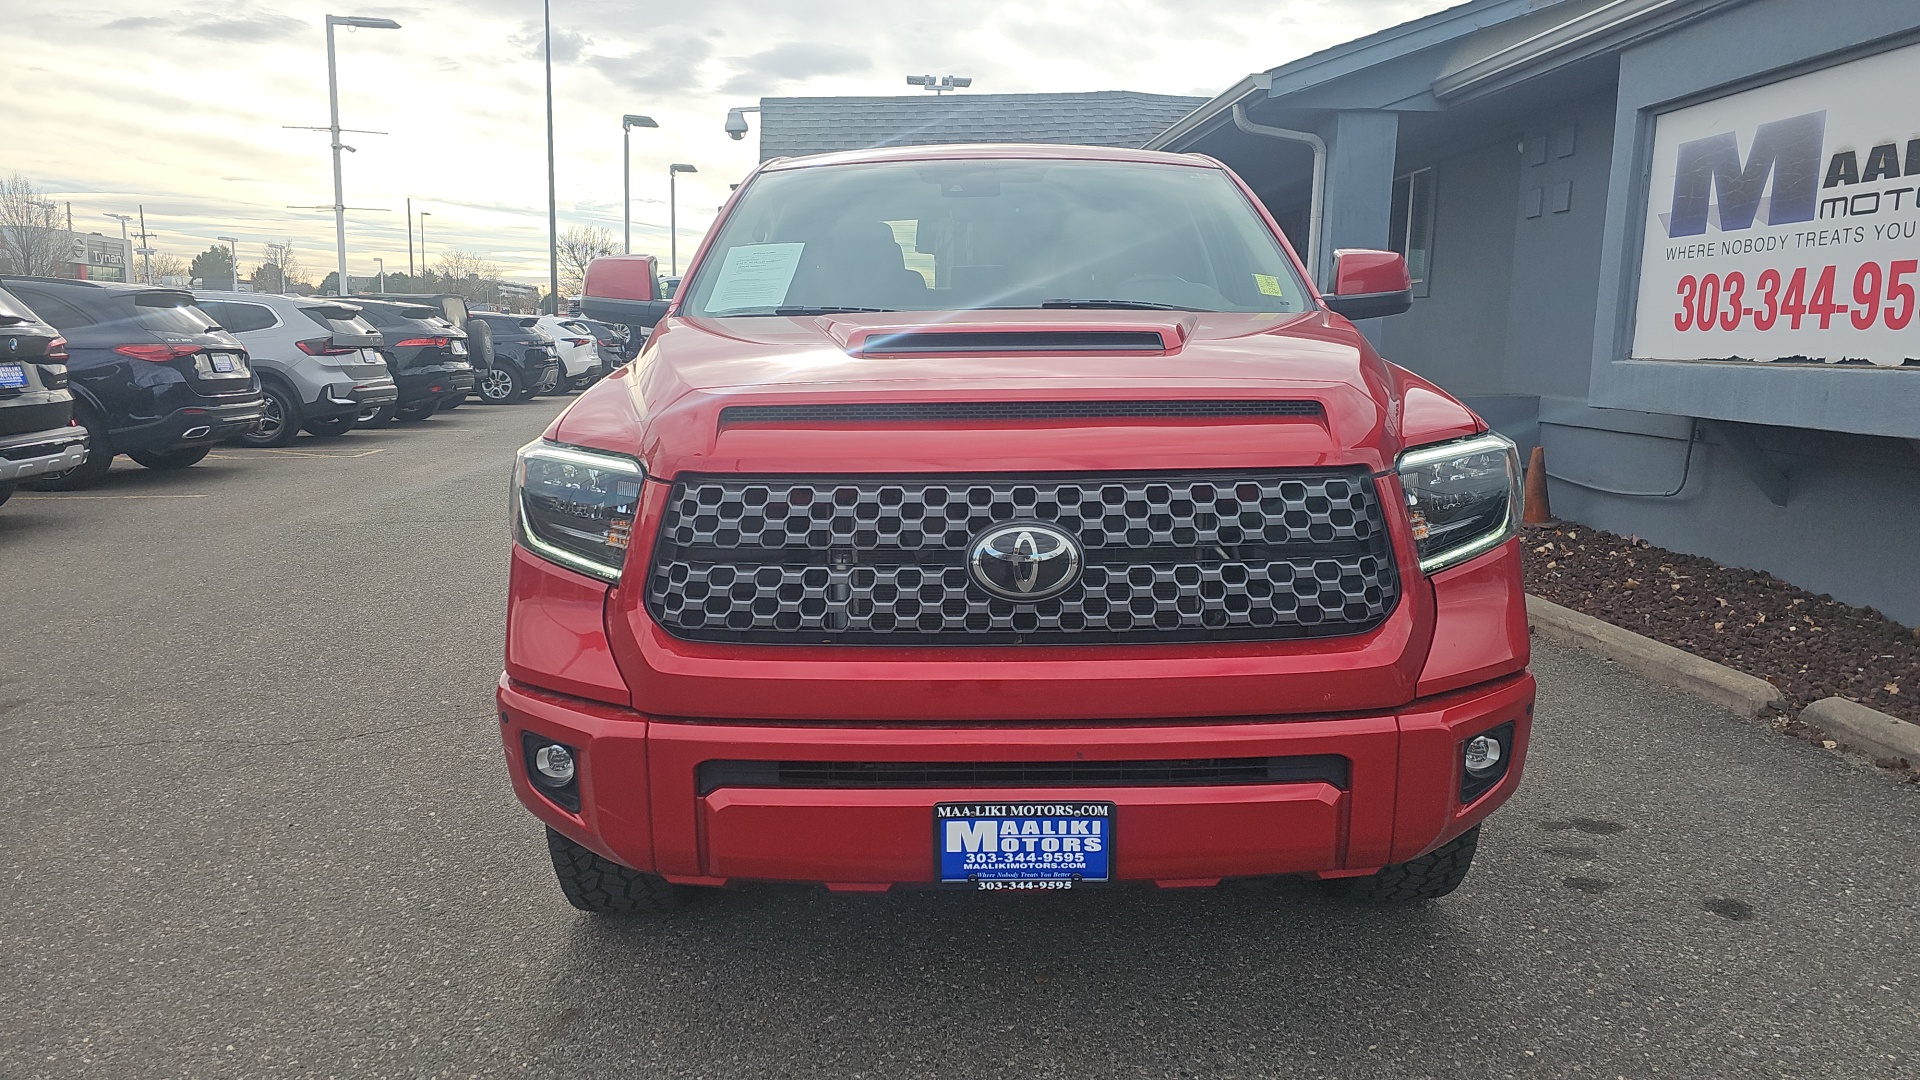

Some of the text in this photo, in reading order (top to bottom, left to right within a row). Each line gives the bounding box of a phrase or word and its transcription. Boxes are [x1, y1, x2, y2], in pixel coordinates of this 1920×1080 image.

[1820, 187, 1920, 219] MOT
[1666, 221, 1916, 261] WHERE NOBODY TREATS YOU
[1674, 259, 1920, 332] 303-344-95
[965, 852, 1085, 863] 303-344-9595
[963, 862, 1086, 870] MAALIKIMOTORS.COM
[997, 871, 1019, 879] Nobody
[977, 881, 1072, 890] 303-344-9595
